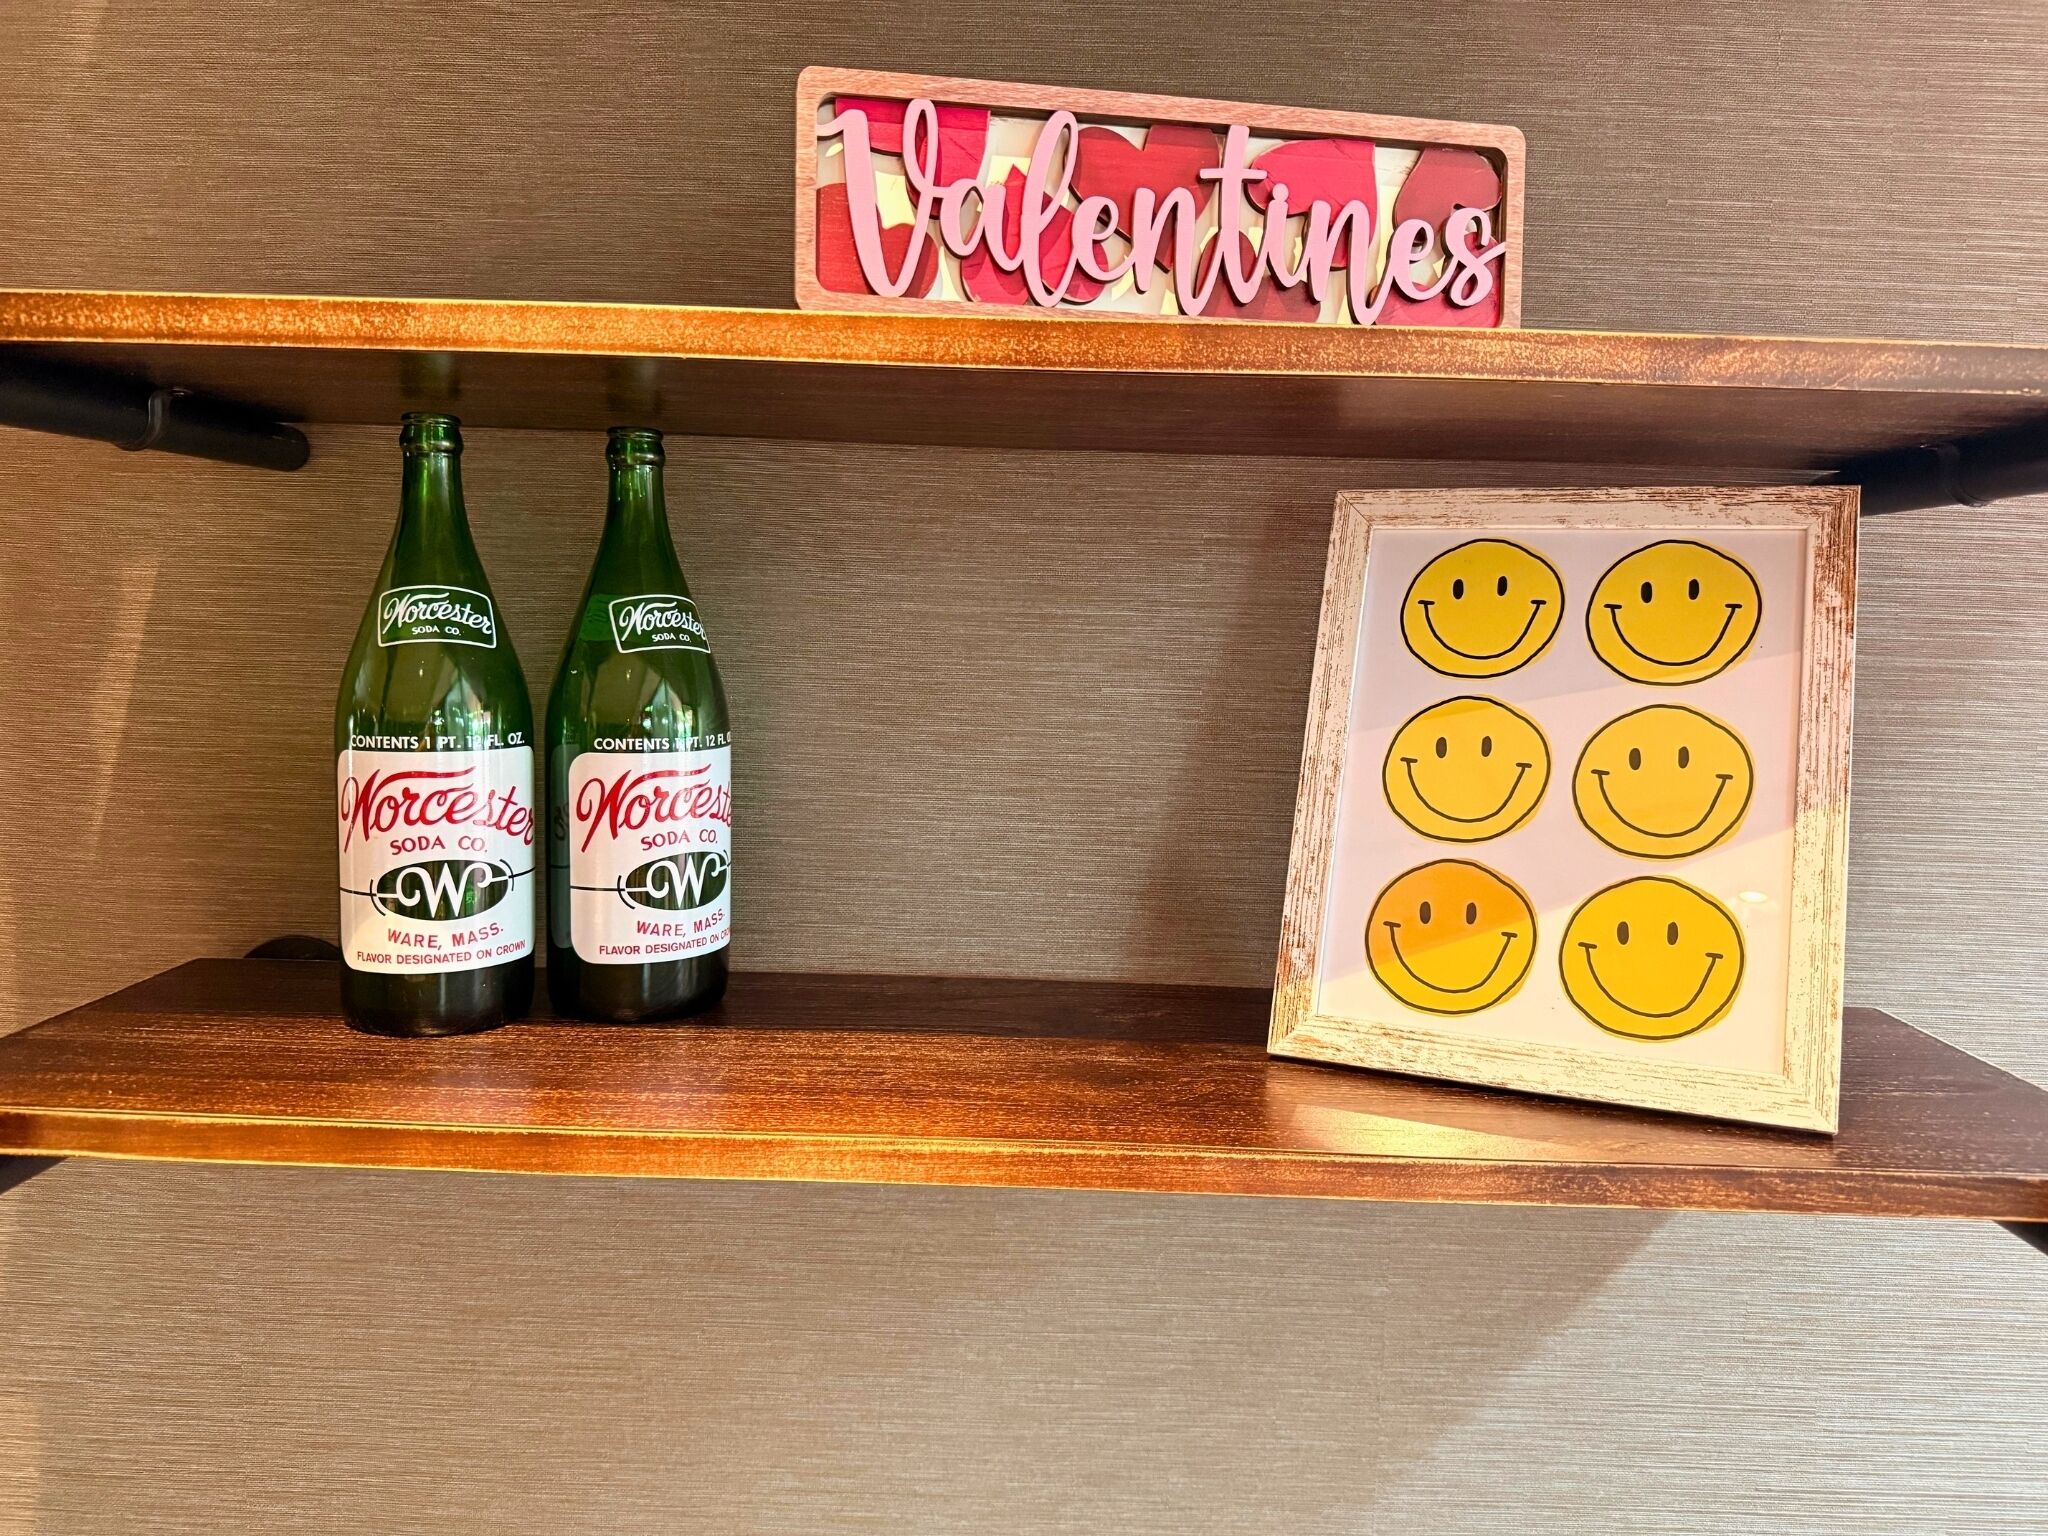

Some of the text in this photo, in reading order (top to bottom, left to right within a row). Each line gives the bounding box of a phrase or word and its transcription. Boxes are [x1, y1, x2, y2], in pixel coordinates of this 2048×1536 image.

[816, 99, 1506, 324] Valentines
[382, 592, 493, 635] Worcester
[619, 601, 707, 641] Worcester
[411, 626, 462, 636] SODA CO.
[651, 632, 692, 643] SODA CO.
[350, 735, 419, 749] CONTENTS
[424, 736, 431, 749] 1
[438, 736, 461, 749] PT.
[486, 734, 504, 747] FL.
[507, 731, 525, 745] OZ.
[593, 737, 670, 750] CONTENTS
[705, 735, 716, 747] 12
[341, 766, 534, 854] Worcester
[390, 835, 488, 856] SODA CO.
[640, 829, 718, 851] SODA CO.
[636, 908, 726, 938] WARE, MASS.
[387, 922, 504, 951] WARE, MASS.
[599, 945, 641, 955] FLAVOR
[645, 936, 707, 954] DESIGNATED
[709, 933, 720, 944] ON
[357, 939, 526, 965] FLAVOR DESIGNATED ON CROWN
